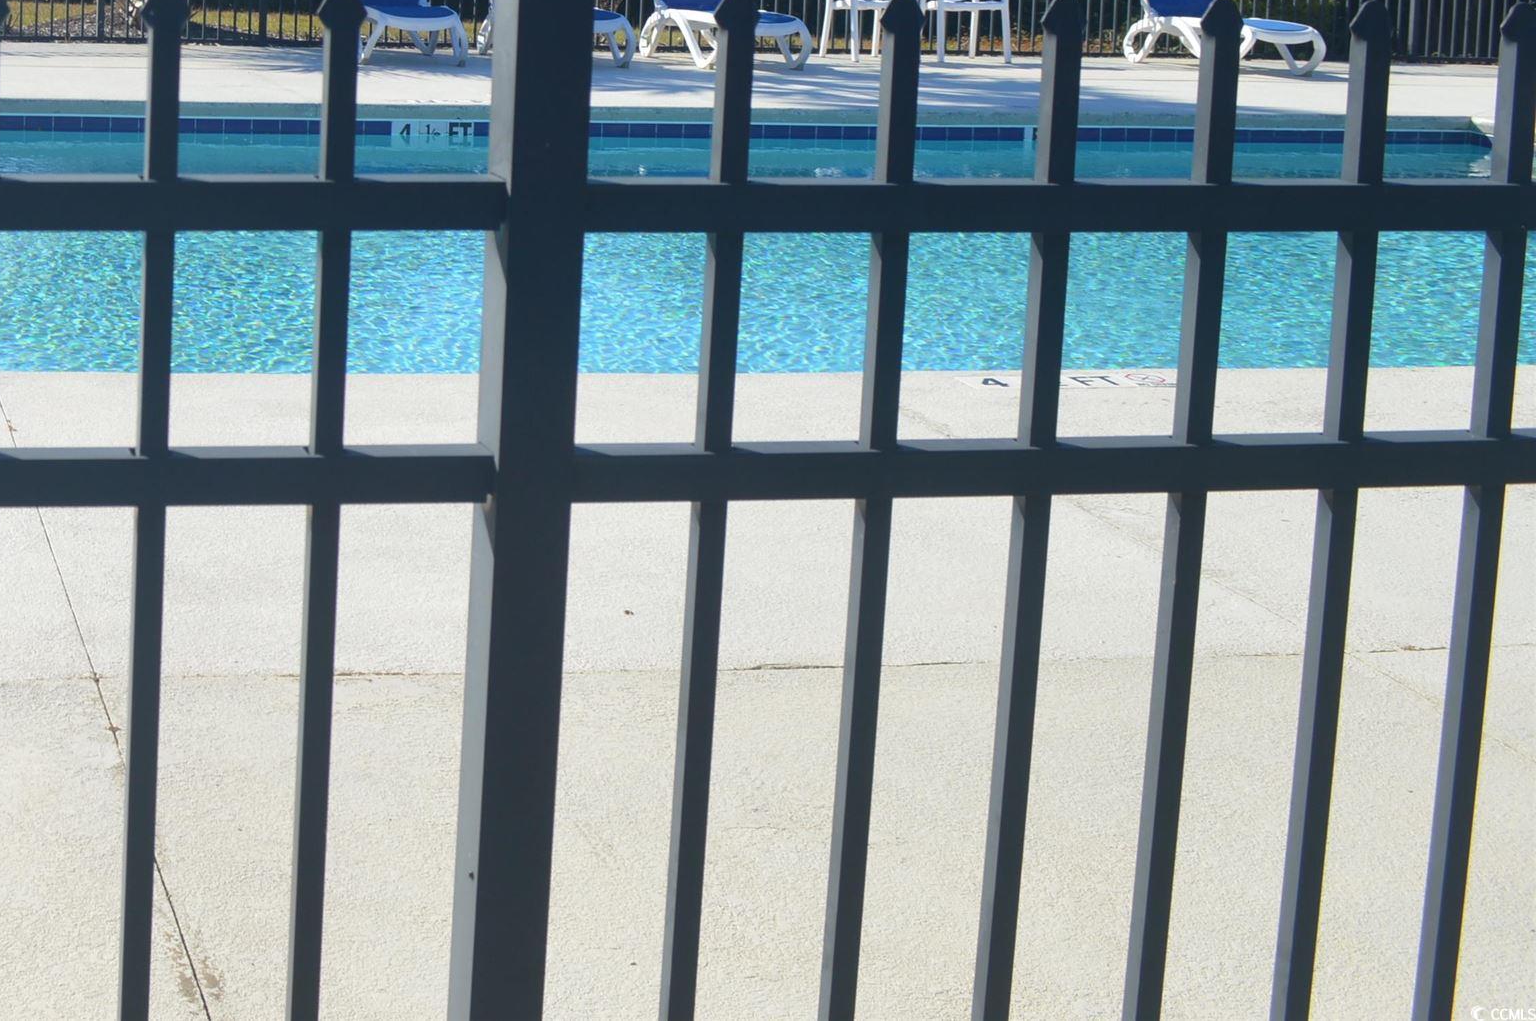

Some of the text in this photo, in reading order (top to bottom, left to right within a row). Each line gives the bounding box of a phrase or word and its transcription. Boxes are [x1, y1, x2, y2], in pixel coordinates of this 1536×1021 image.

[449, 121, 473, 137] FT
[982, 375, 1120, 388] 4 FT
